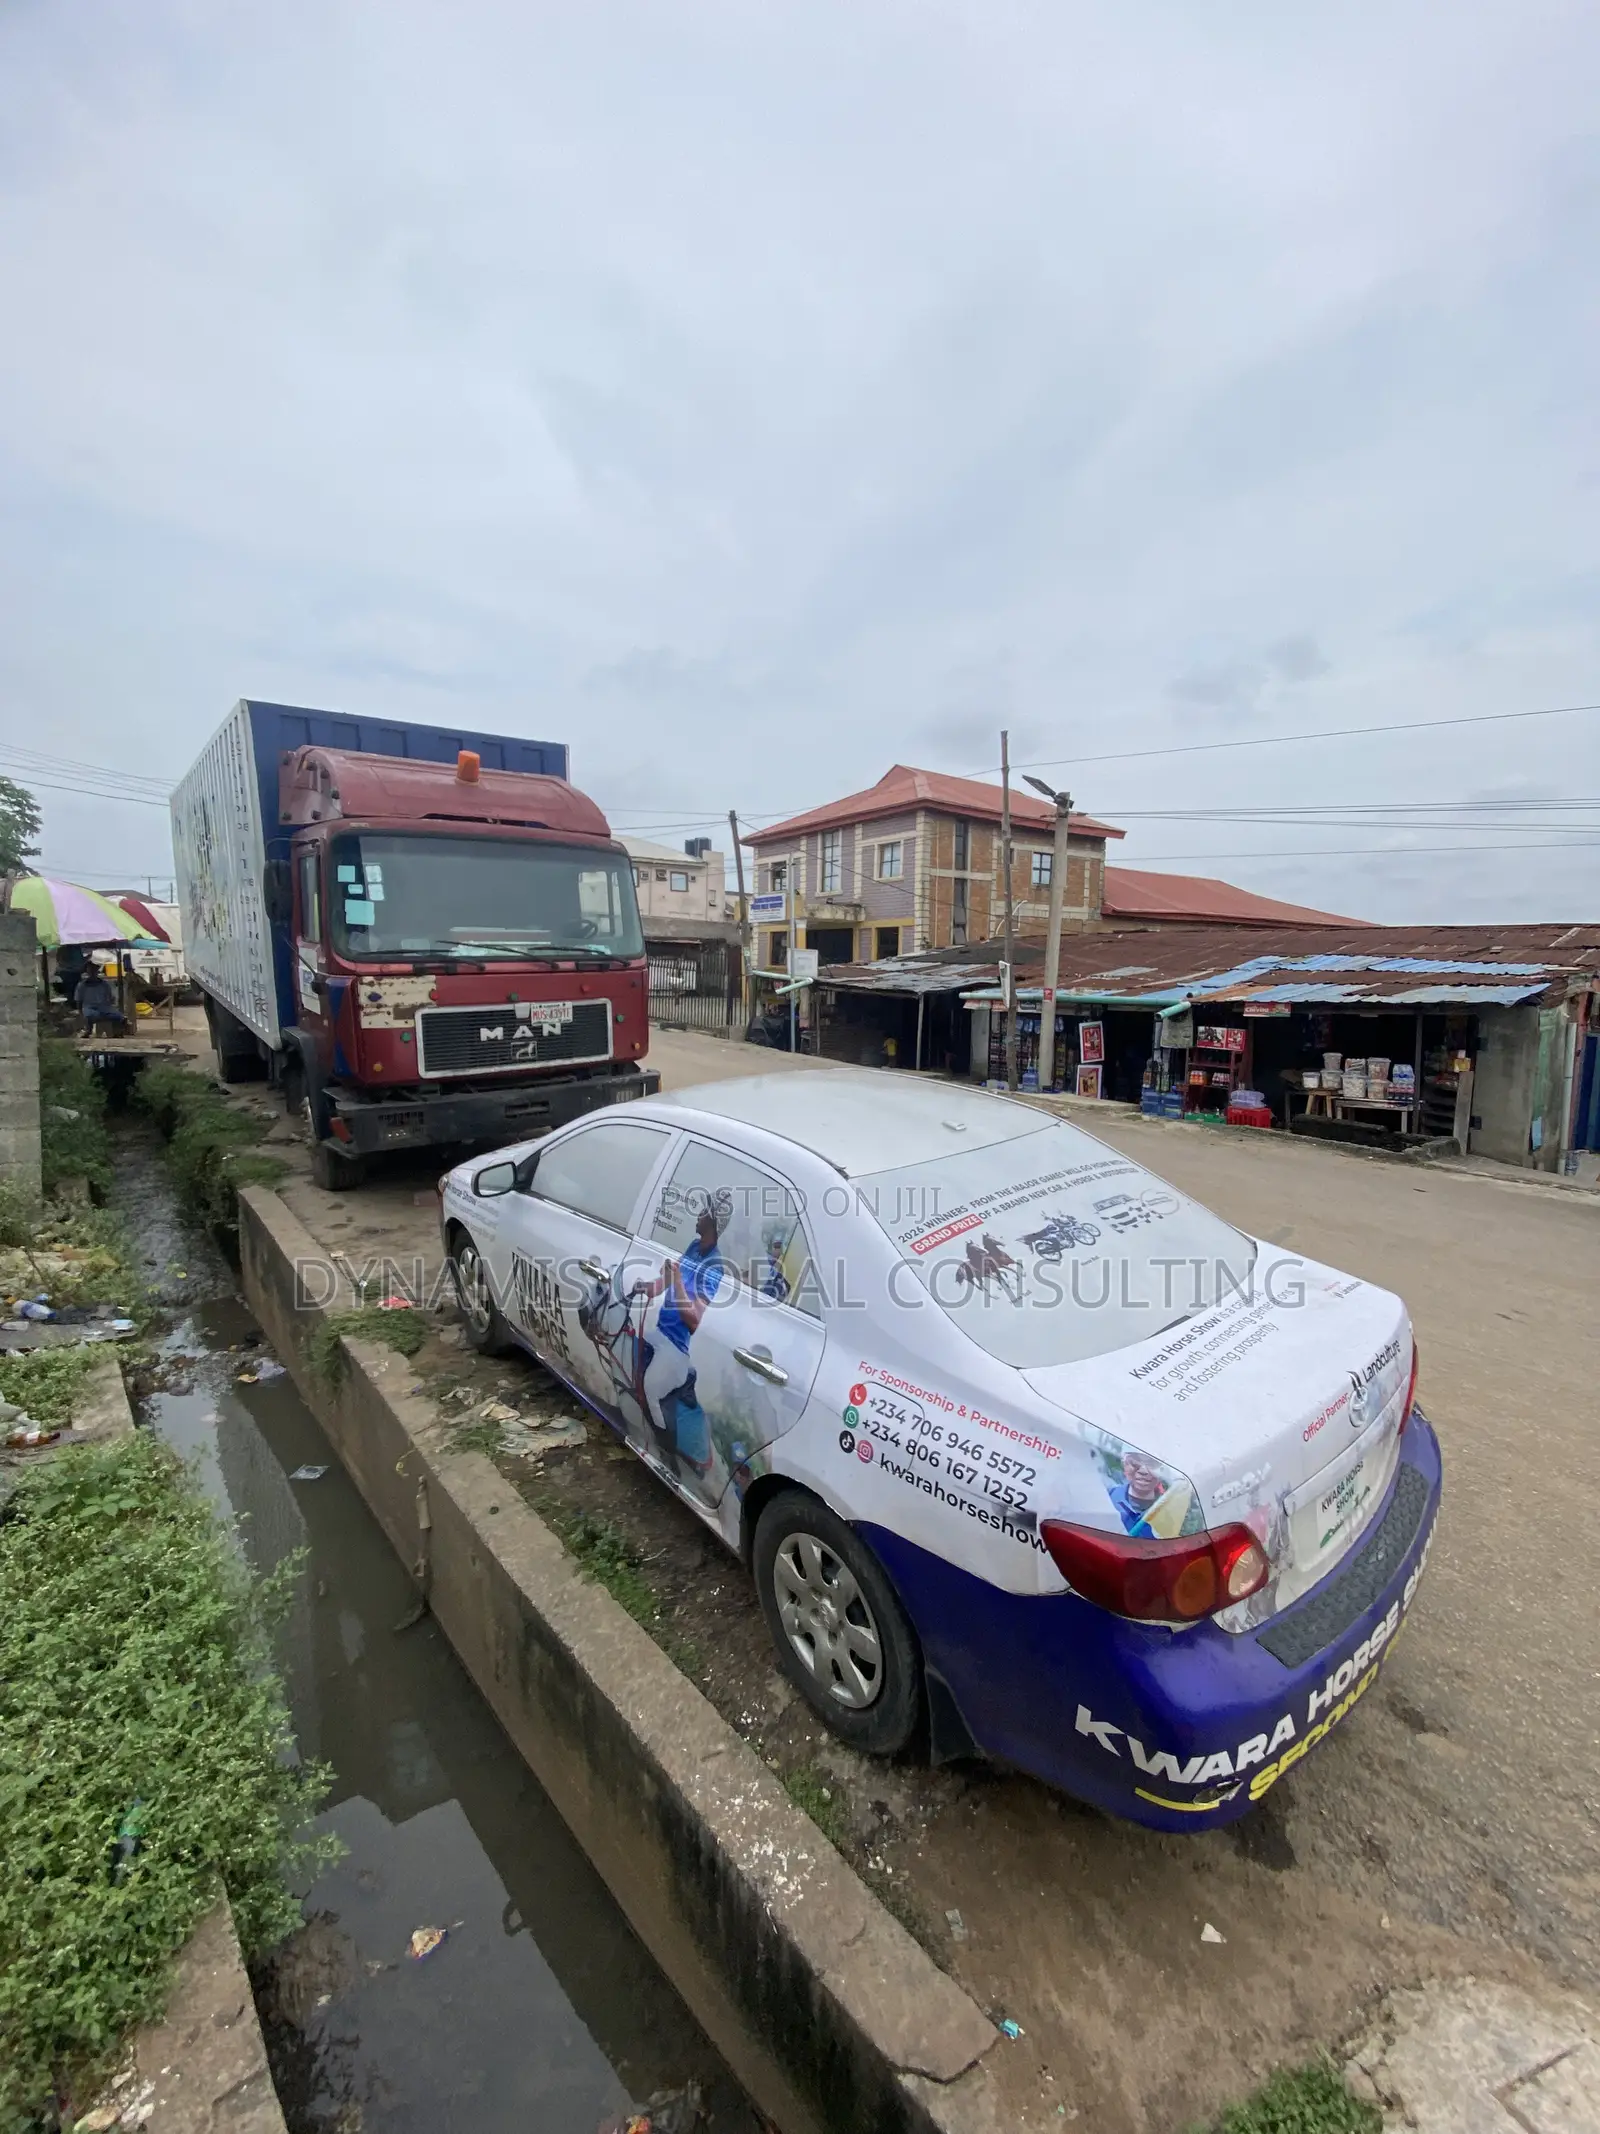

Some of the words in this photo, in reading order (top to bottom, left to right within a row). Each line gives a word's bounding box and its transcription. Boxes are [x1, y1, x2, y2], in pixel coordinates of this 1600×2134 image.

[480, 1022, 562, 1042] MAN
[898, 1226, 925, 1244] 2026
[923, 1204, 969, 1229] WINNERS
[969, 1194, 998, 1208] FROM
[994, 1187, 1014, 1199] THE
[1011, 1178, 1040, 1193] MAJOR
[1038, 1170, 1066, 1183] GAMES
[914, 1228, 952, 1252] GRAND
[951, 1215, 981, 1233] PRIZE
[978, 1209, 992, 1221] OF
[992, 1206, 1002, 1215] A
[998, 1194, 1030, 1212] BRAND
[1027, 1188, 1049, 1201] NEW
[1063, 1180, 1074, 1188] A
[1070, 1174, 1096, 1188] HORSE
[1129, 1354, 1168, 1380] Kwara
[1161, 1333, 1197, 1356] Horse
[1190, 1316, 1221, 1336] Show
[1216, 1311, 1231, 1320] is
[1149, 1375, 1172, 1391] for
[1168, 1350, 1211, 1381] growth,
[1203, 1316, 1257, 1351] connecting
[1173, 1380, 1200, 1402] and
[1190, 1351, 1241, 1386] fostering
[1233, 1321, 1279, 1356] prosperity
[858, 1360, 879, 1378] For
[878, 1370, 955, 1413] Sponsorship
[957, 1404, 968, 1418] &
[970, 1409, 1064, 1460] Partnership:
[1303, 1413, 1327, 1442] Official
[1362, 1339, 1401, 1384] Landculture
[862, 1419, 902, 1448] +234
[905, 1438, 942, 1468] 806
[946, 1457, 978, 1485] 167
[983, 1475, 1029, 1512] 1252
[869, 1397, 907, 1425] +234
[911, 1414, 944, 1442] 706
[946, 1432, 985, 1461] 946
[986, 1450, 1037, 1487] 5572
[880, 1452, 1050, 1555] kwarahorseshow
[1320, 1481, 1346, 1513] KWARA
[1074, 1703, 1297, 1785] KWARA
[1307, 1600, 1399, 1724] HORSE
[1248, 1661, 1380, 1801] SECOND
